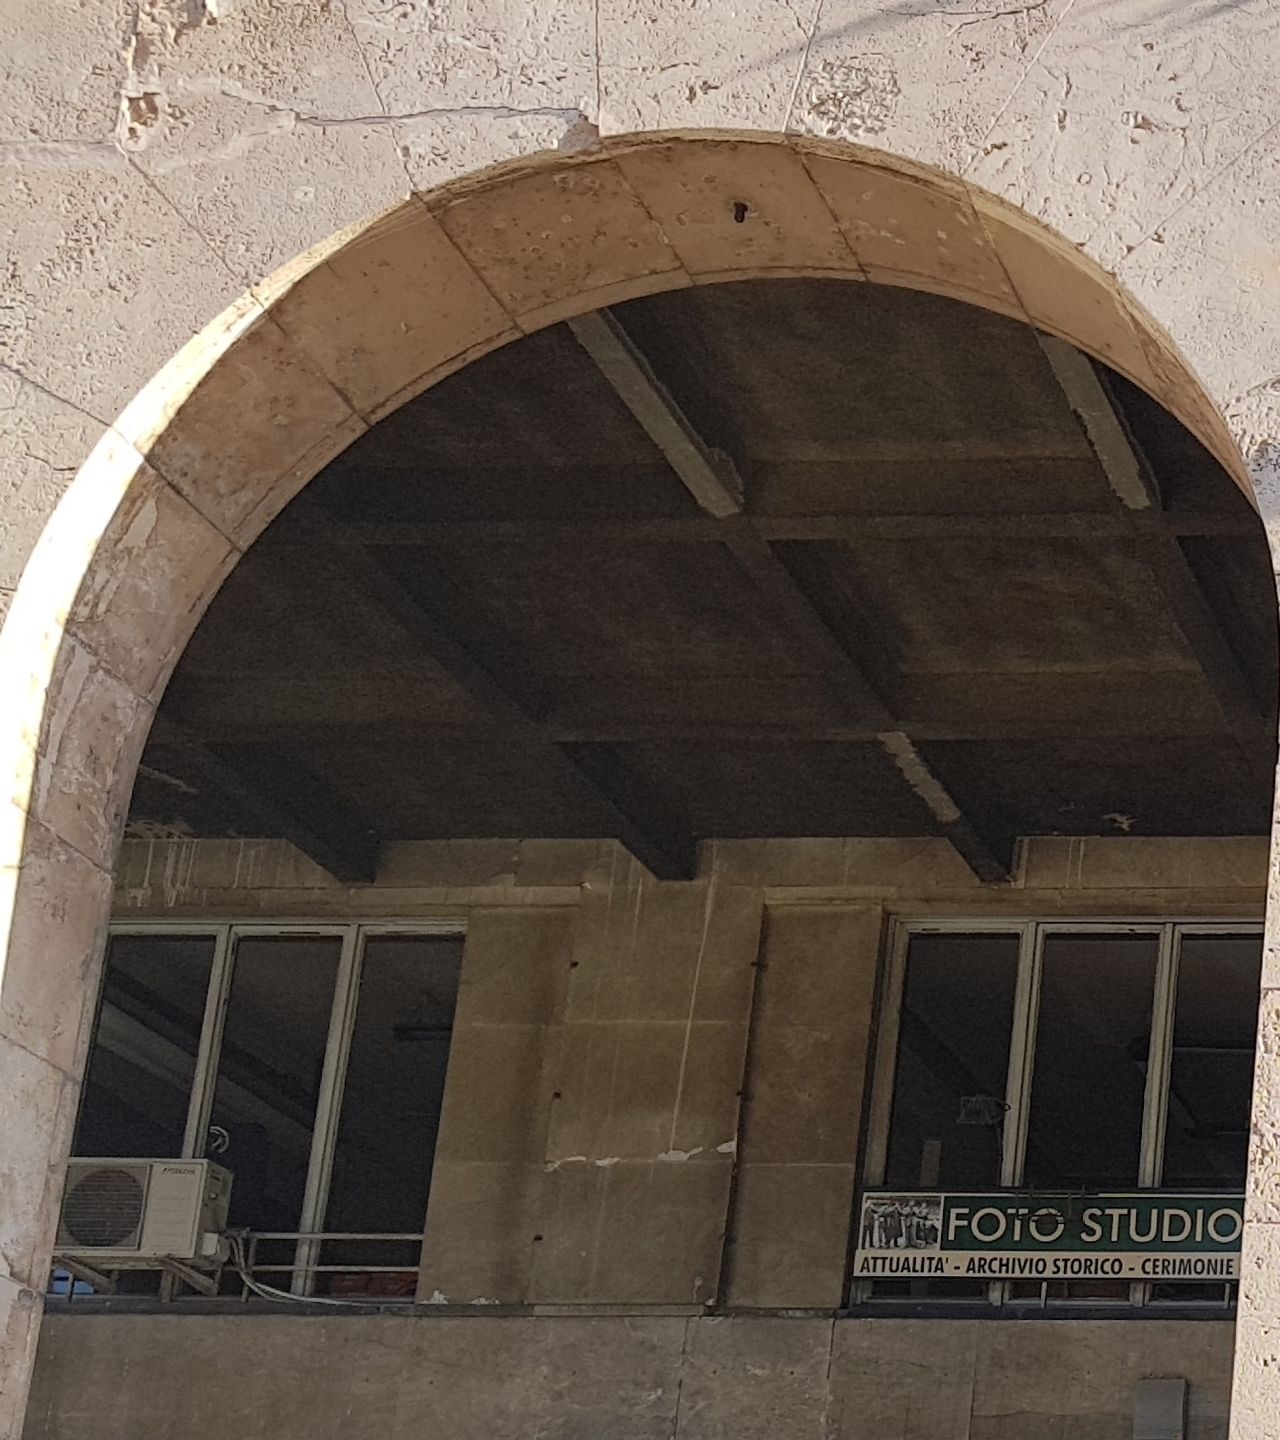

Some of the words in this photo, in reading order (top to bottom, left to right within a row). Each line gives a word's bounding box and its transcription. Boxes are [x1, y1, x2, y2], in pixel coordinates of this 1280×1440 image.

[948, 1206, 1065, 1243] FOTO
[1080, 1207, 1243, 1244] STUDIO
[860, 1256, 949, 1274] ATTUALITA'
[966, 1257, 1047, 1275] ARCHIVIO
[1051, 1258, 1124, 1276] STORICO
[1141, 1258, 1234, 1276] CERIMONIE
